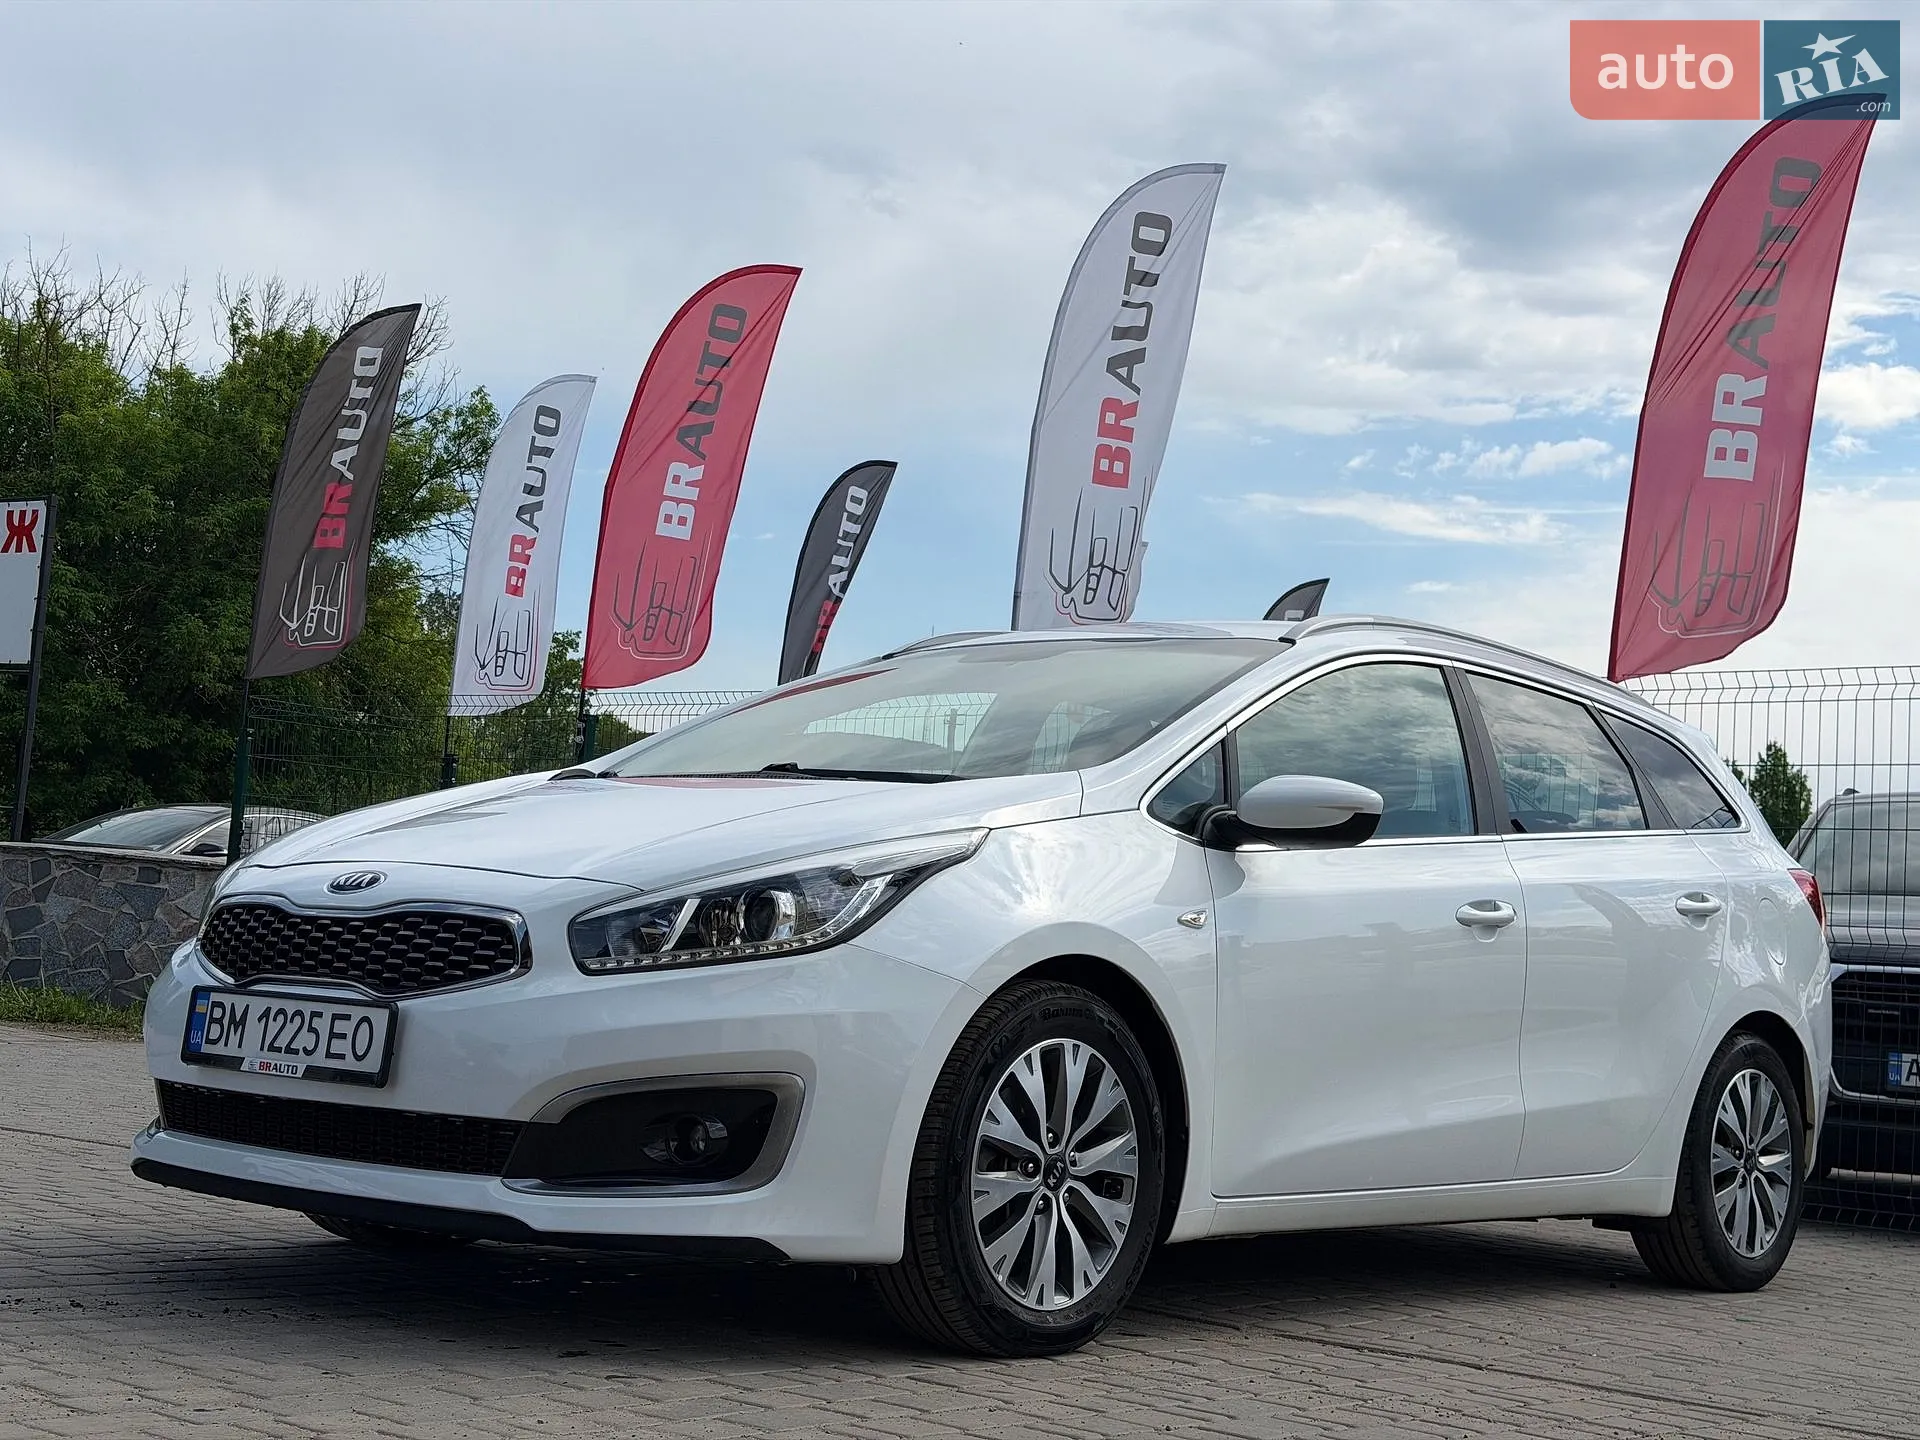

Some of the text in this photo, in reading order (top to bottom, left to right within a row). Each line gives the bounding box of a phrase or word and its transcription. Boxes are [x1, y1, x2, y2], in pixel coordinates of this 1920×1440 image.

[1091, 211, 1173, 489] BRAUTO
[1703, 156, 1823, 482] BRAUTO
[313, 346, 385, 549] BRAUTO
[655, 302, 748, 542] BRAUTO
[0, 509, 39, 553] Ж
[504, 404, 563, 599] BRAUTO
[332, 872, 374, 887] KIA
[190, 1029, 202, 1044] UA
[204, 1000, 374, 1062] BM 1225 EO
[258, 1060, 298, 1075] BRAUTO
